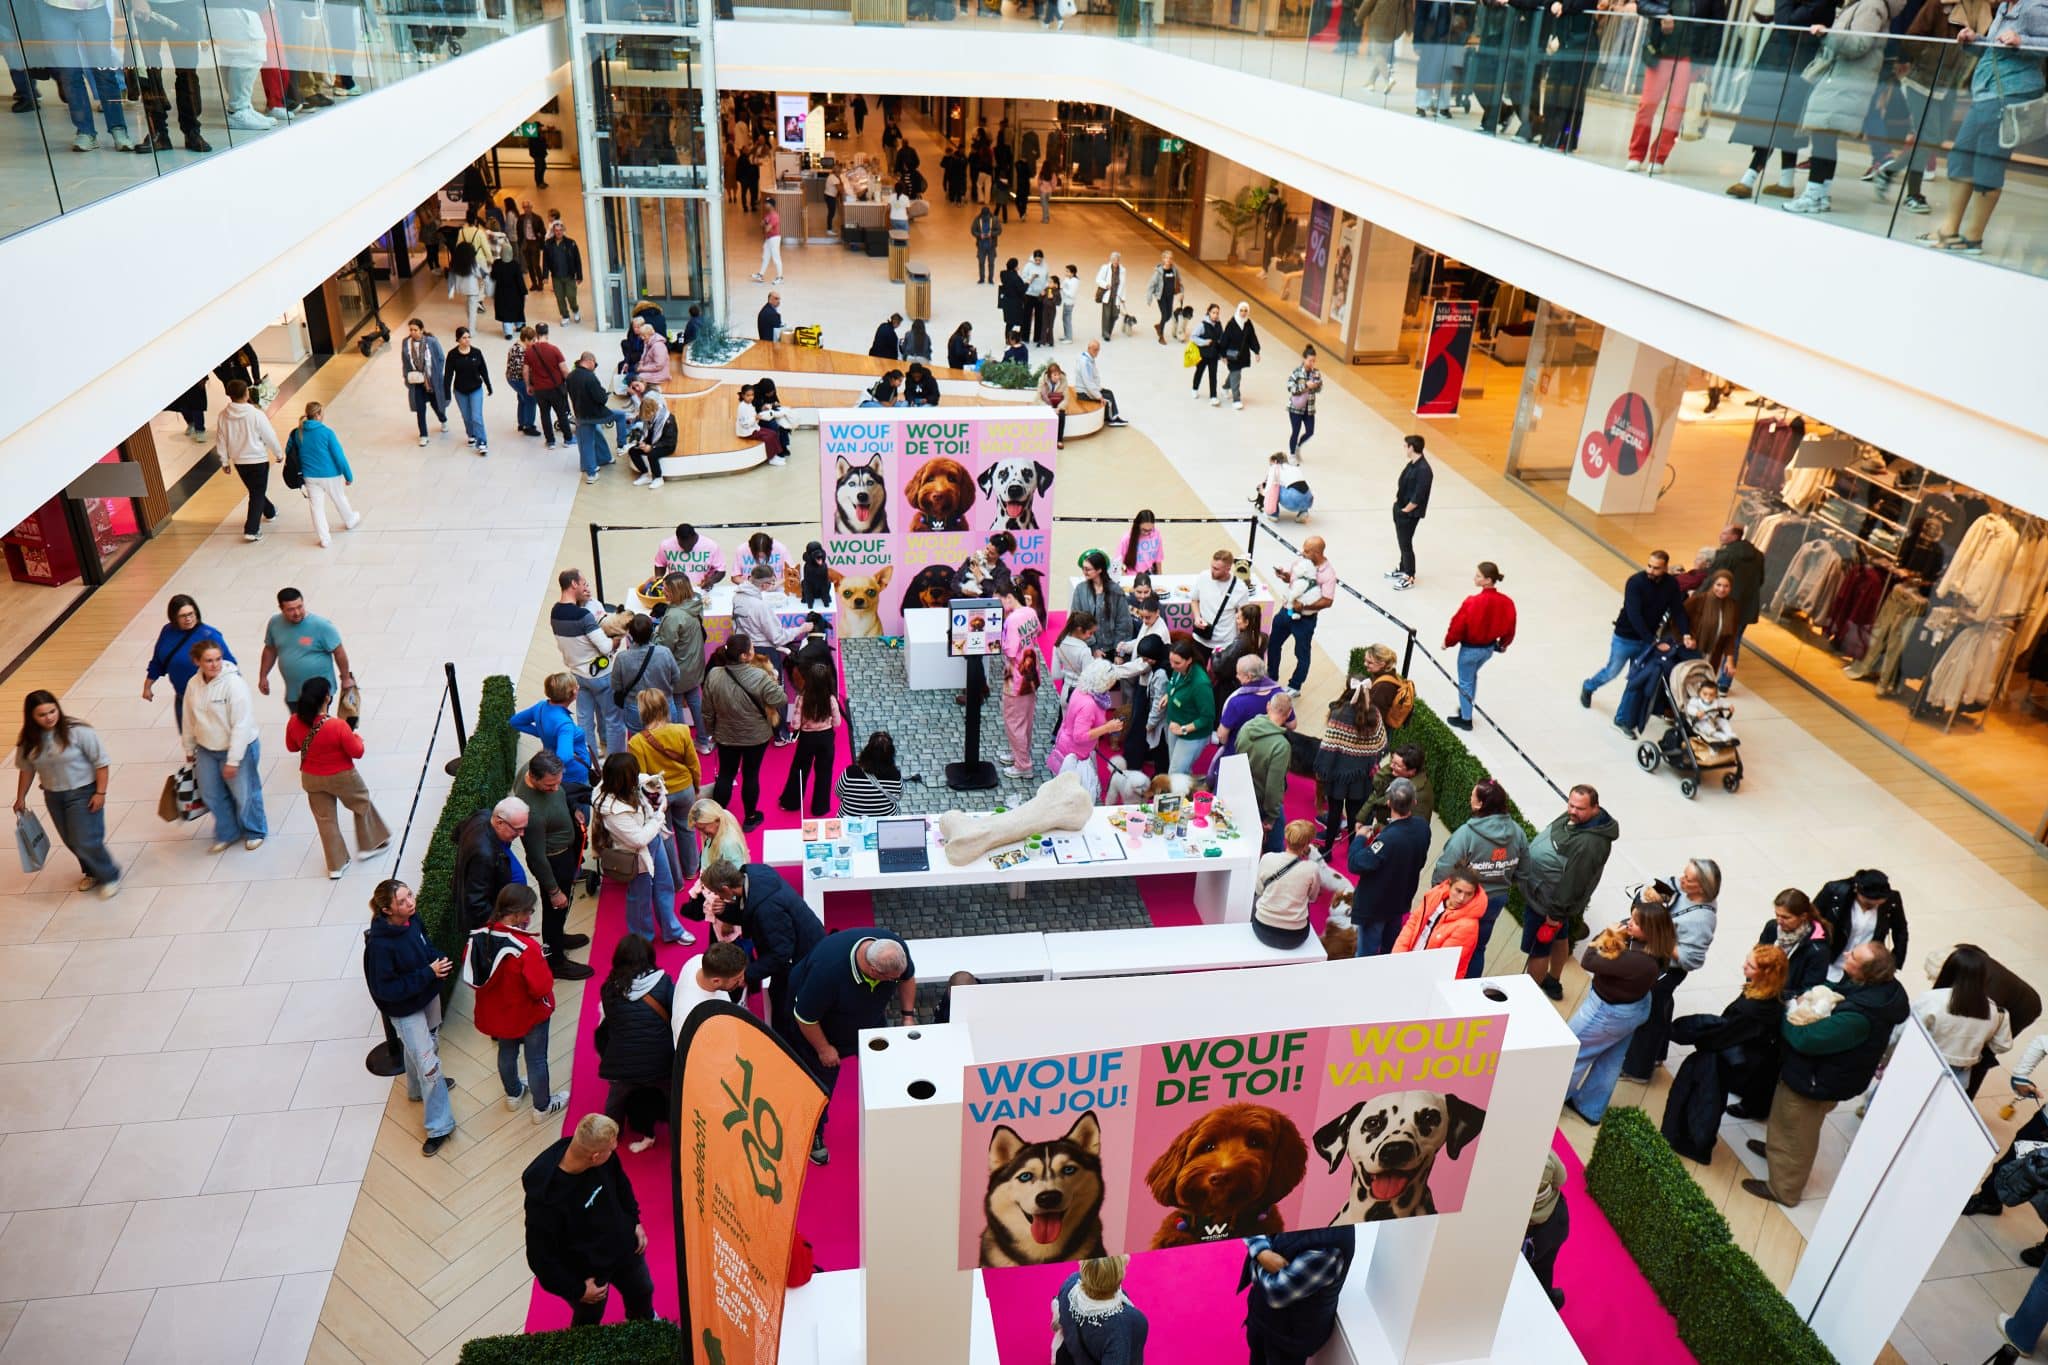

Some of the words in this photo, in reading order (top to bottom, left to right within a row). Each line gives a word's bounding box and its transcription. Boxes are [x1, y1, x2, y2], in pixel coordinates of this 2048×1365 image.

[1436, 314, 1472, 322] SPECIAL
[830, 424, 890, 440] WOUF
[906, 423, 969, 439] WOUF
[987, 422, 1048, 438] WOUF
[1611, 425, 1643, 452] SPECIAL
[826, 442, 859, 453] VAN
[860, 441, 894, 453] JOU!
[905, 441, 929, 455] DE
[933, 440, 970, 455] TOI!
[830, 540, 885, 553] WOUF
[906, 534, 963, 549] WOUF
[664, 550, 710, 562] WOUF
[828, 554, 858, 565] VAN
[859, 554, 891, 565] JOU!
[703, 617, 732, 629] WO
[1350, 1020, 1493, 1057] WOUF
[1161, 1031, 1308, 1075] WOUF
[978, 1052, 1123, 1096] WOUF
[1327, 1058, 1406, 1088] VAN
[1412, 1051, 1498, 1081] JOU!
[1156, 1078, 1210, 1107] DE
[1222, 1065, 1305, 1099] TOI!
[968, 1096, 1042, 1124] VAN
[1048, 1085, 1128, 1117] JOU!
